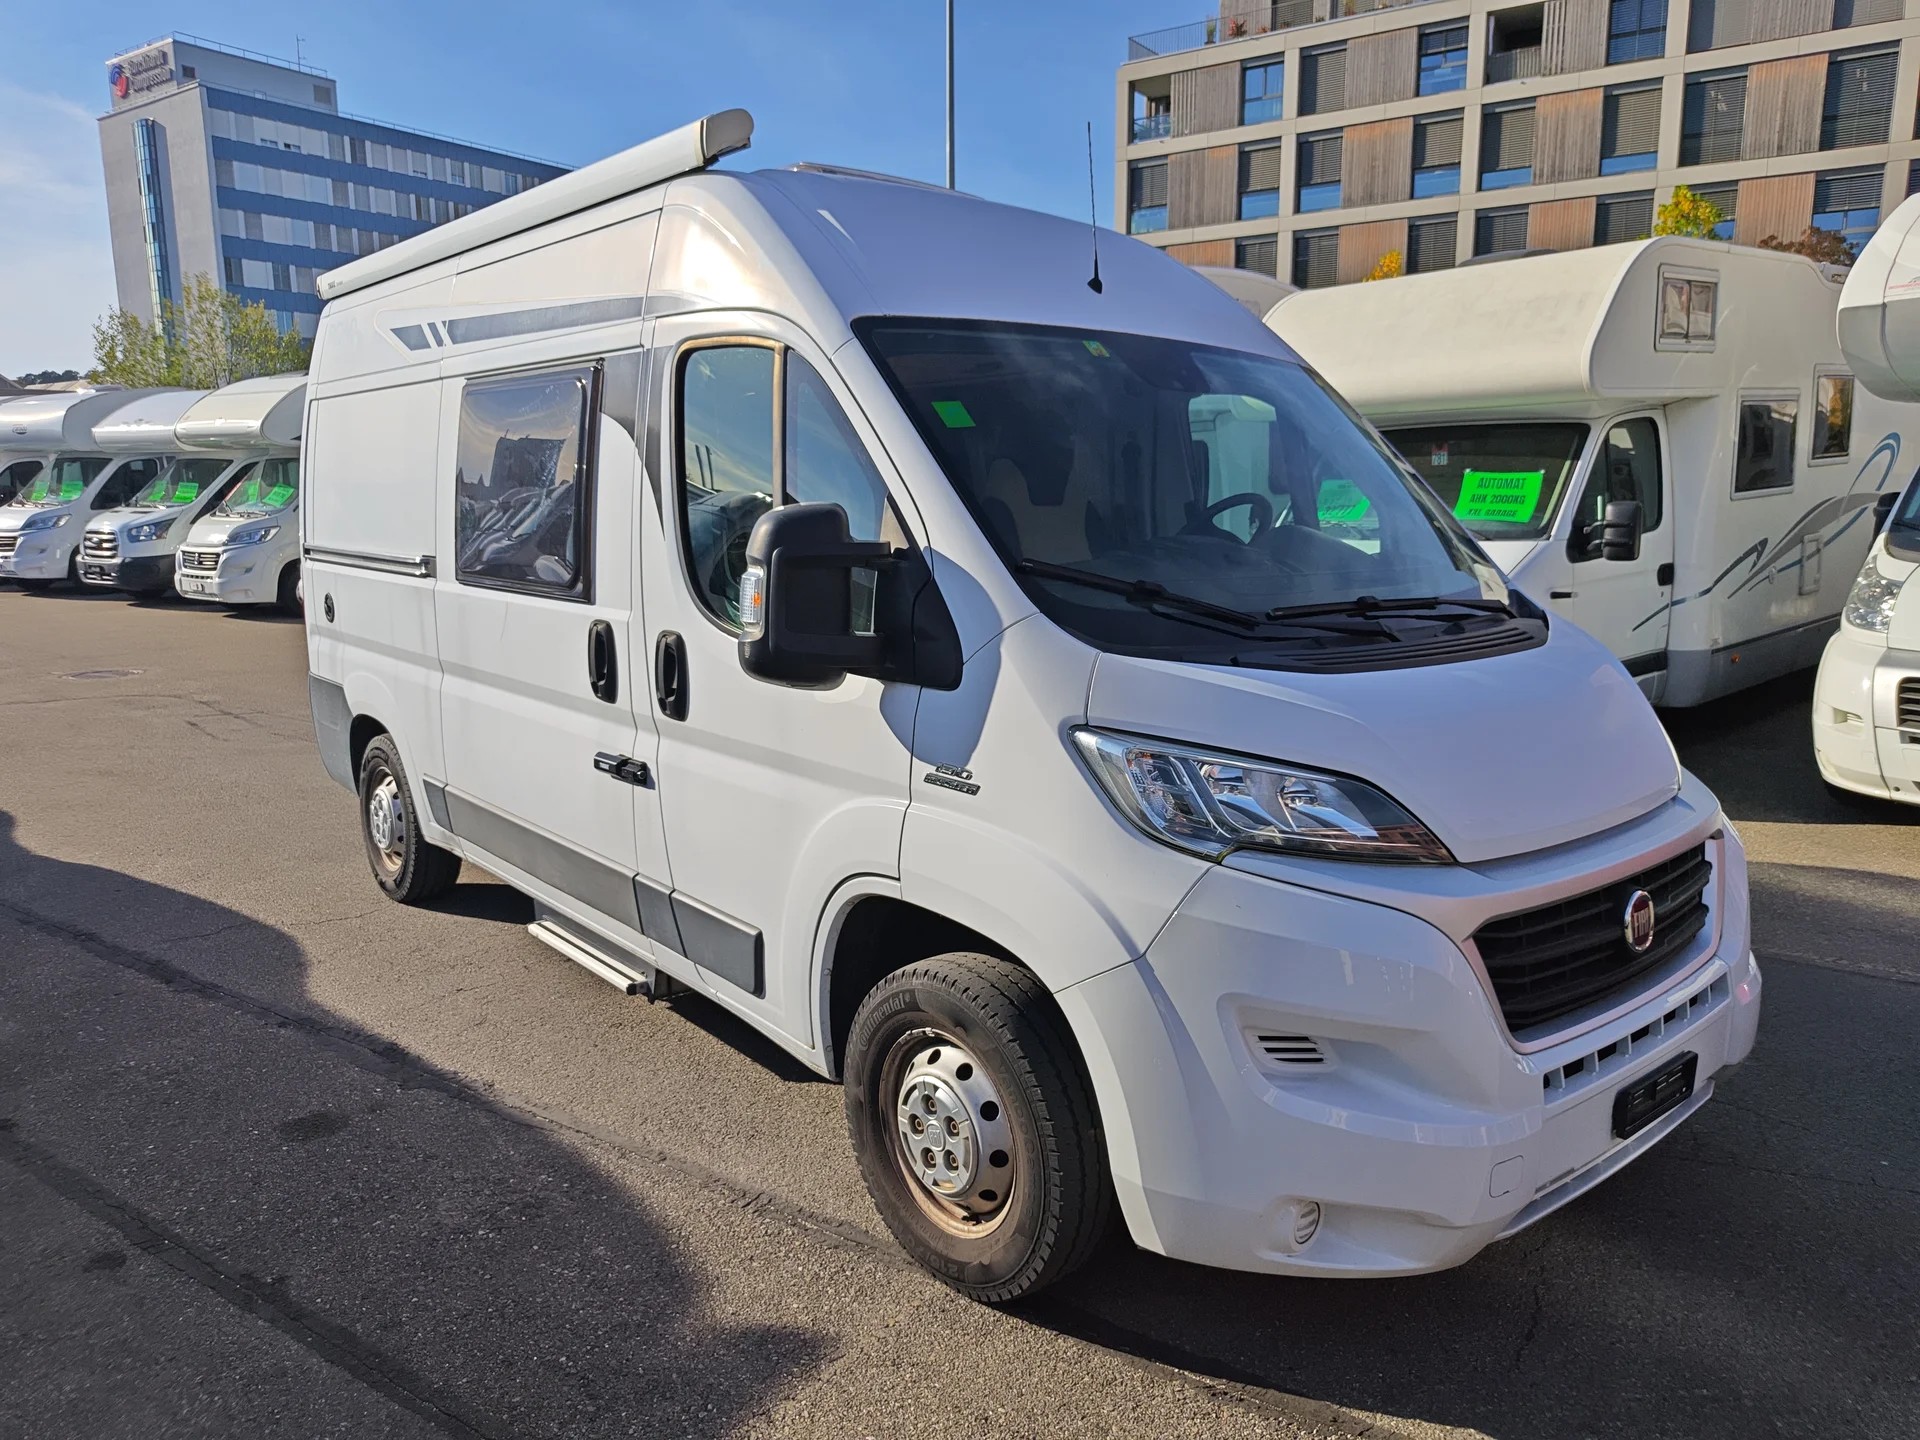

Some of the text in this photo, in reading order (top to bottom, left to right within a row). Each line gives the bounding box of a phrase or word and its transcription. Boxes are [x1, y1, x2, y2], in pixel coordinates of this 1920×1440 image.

[1477, 477, 1526, 490] AUTOMAT
[1470, 493, 1526, 505] AHK 2000KG
[1633, 907, 1650, 938] FIAT
[859, 992, 906, 1048] Continental
